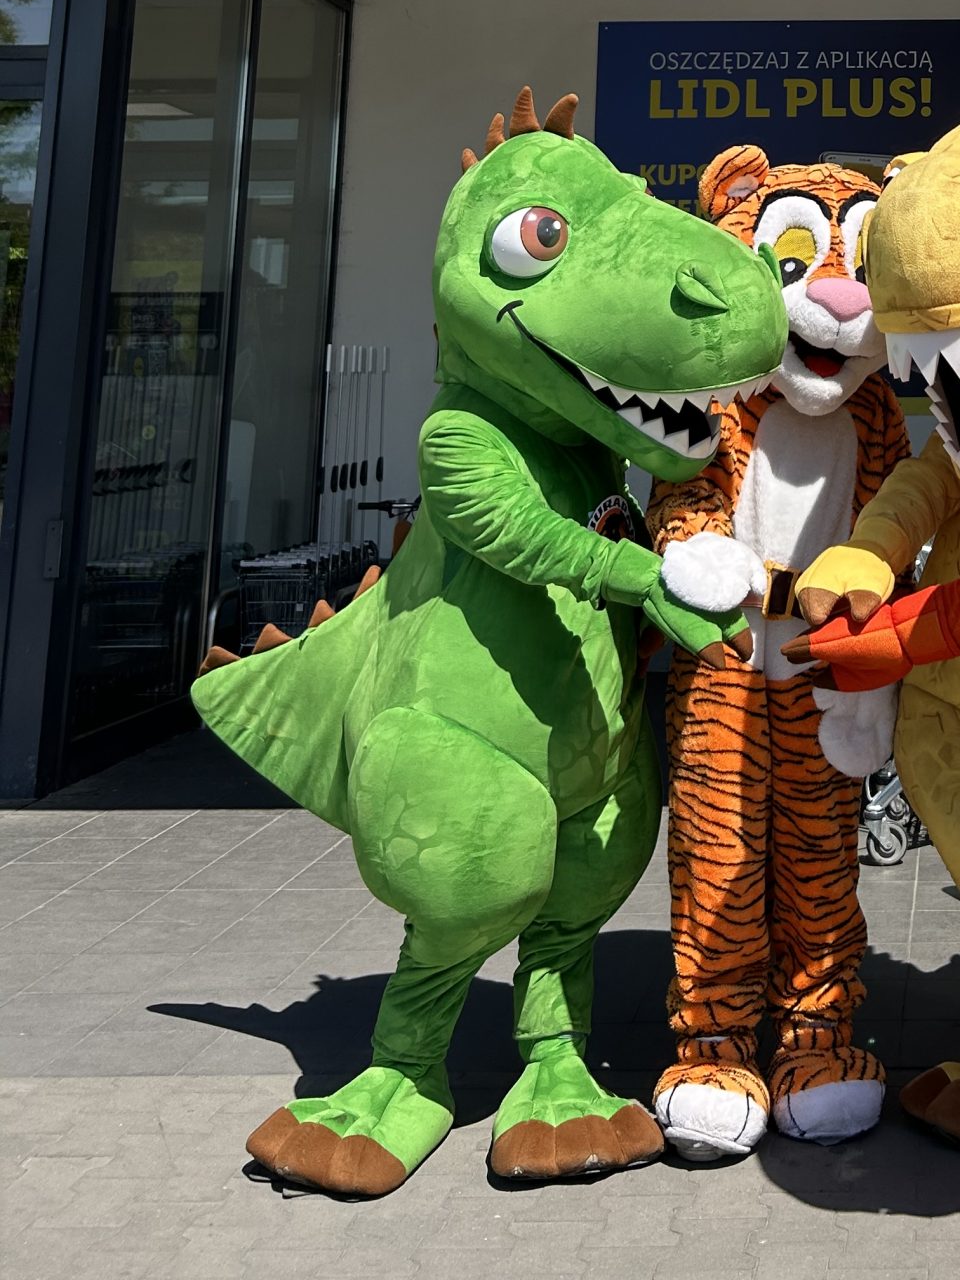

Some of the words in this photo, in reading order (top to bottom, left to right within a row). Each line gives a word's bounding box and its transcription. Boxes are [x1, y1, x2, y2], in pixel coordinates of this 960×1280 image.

[650, 51, 789, 74] OSZCZĘDZAJ
[796, 52, 809, 68] Z
[815, 50, 934, 72] APLIKACJĄ
[649, 78, 770, 119] LIDL
[783, 77, 932, 118] PLUS!
[640, 163, 708, 186] KUP
